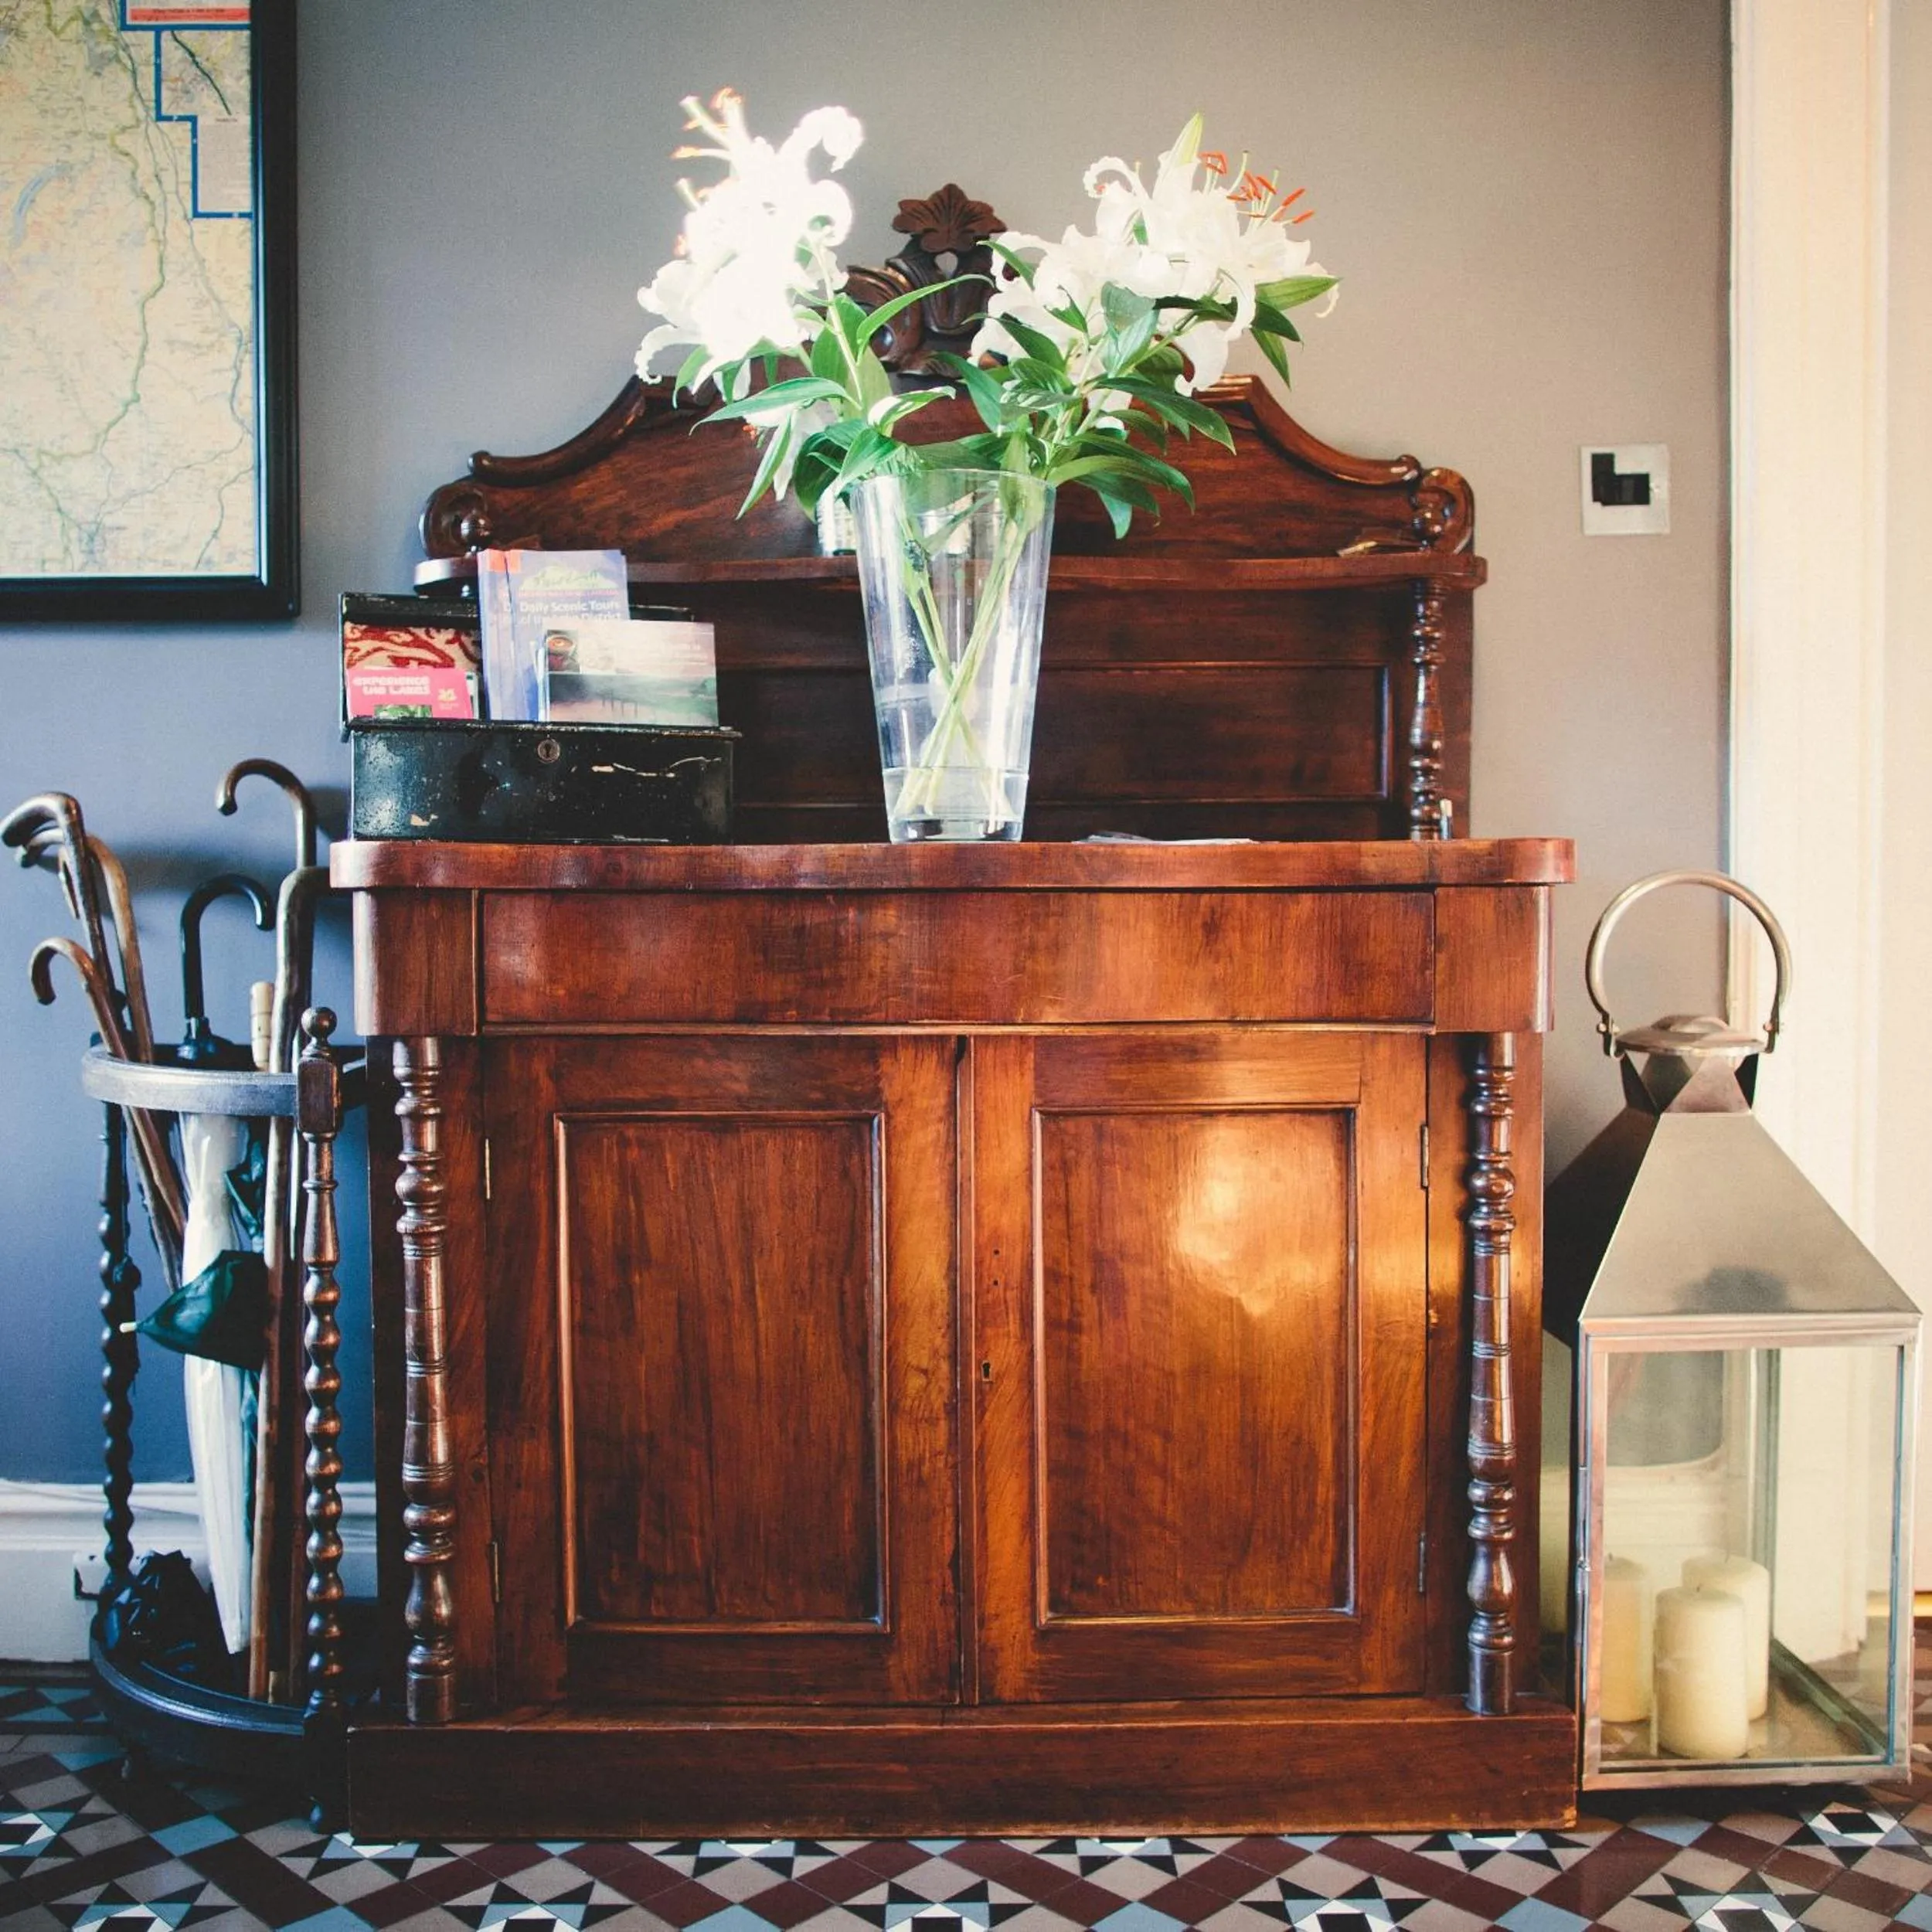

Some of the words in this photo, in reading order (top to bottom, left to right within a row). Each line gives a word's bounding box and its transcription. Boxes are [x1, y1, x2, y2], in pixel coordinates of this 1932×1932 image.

[520, 602, 549, 614] Daily
[551, 601, 588, 611] Scenic
[588, 600, 621, 611] Tours
